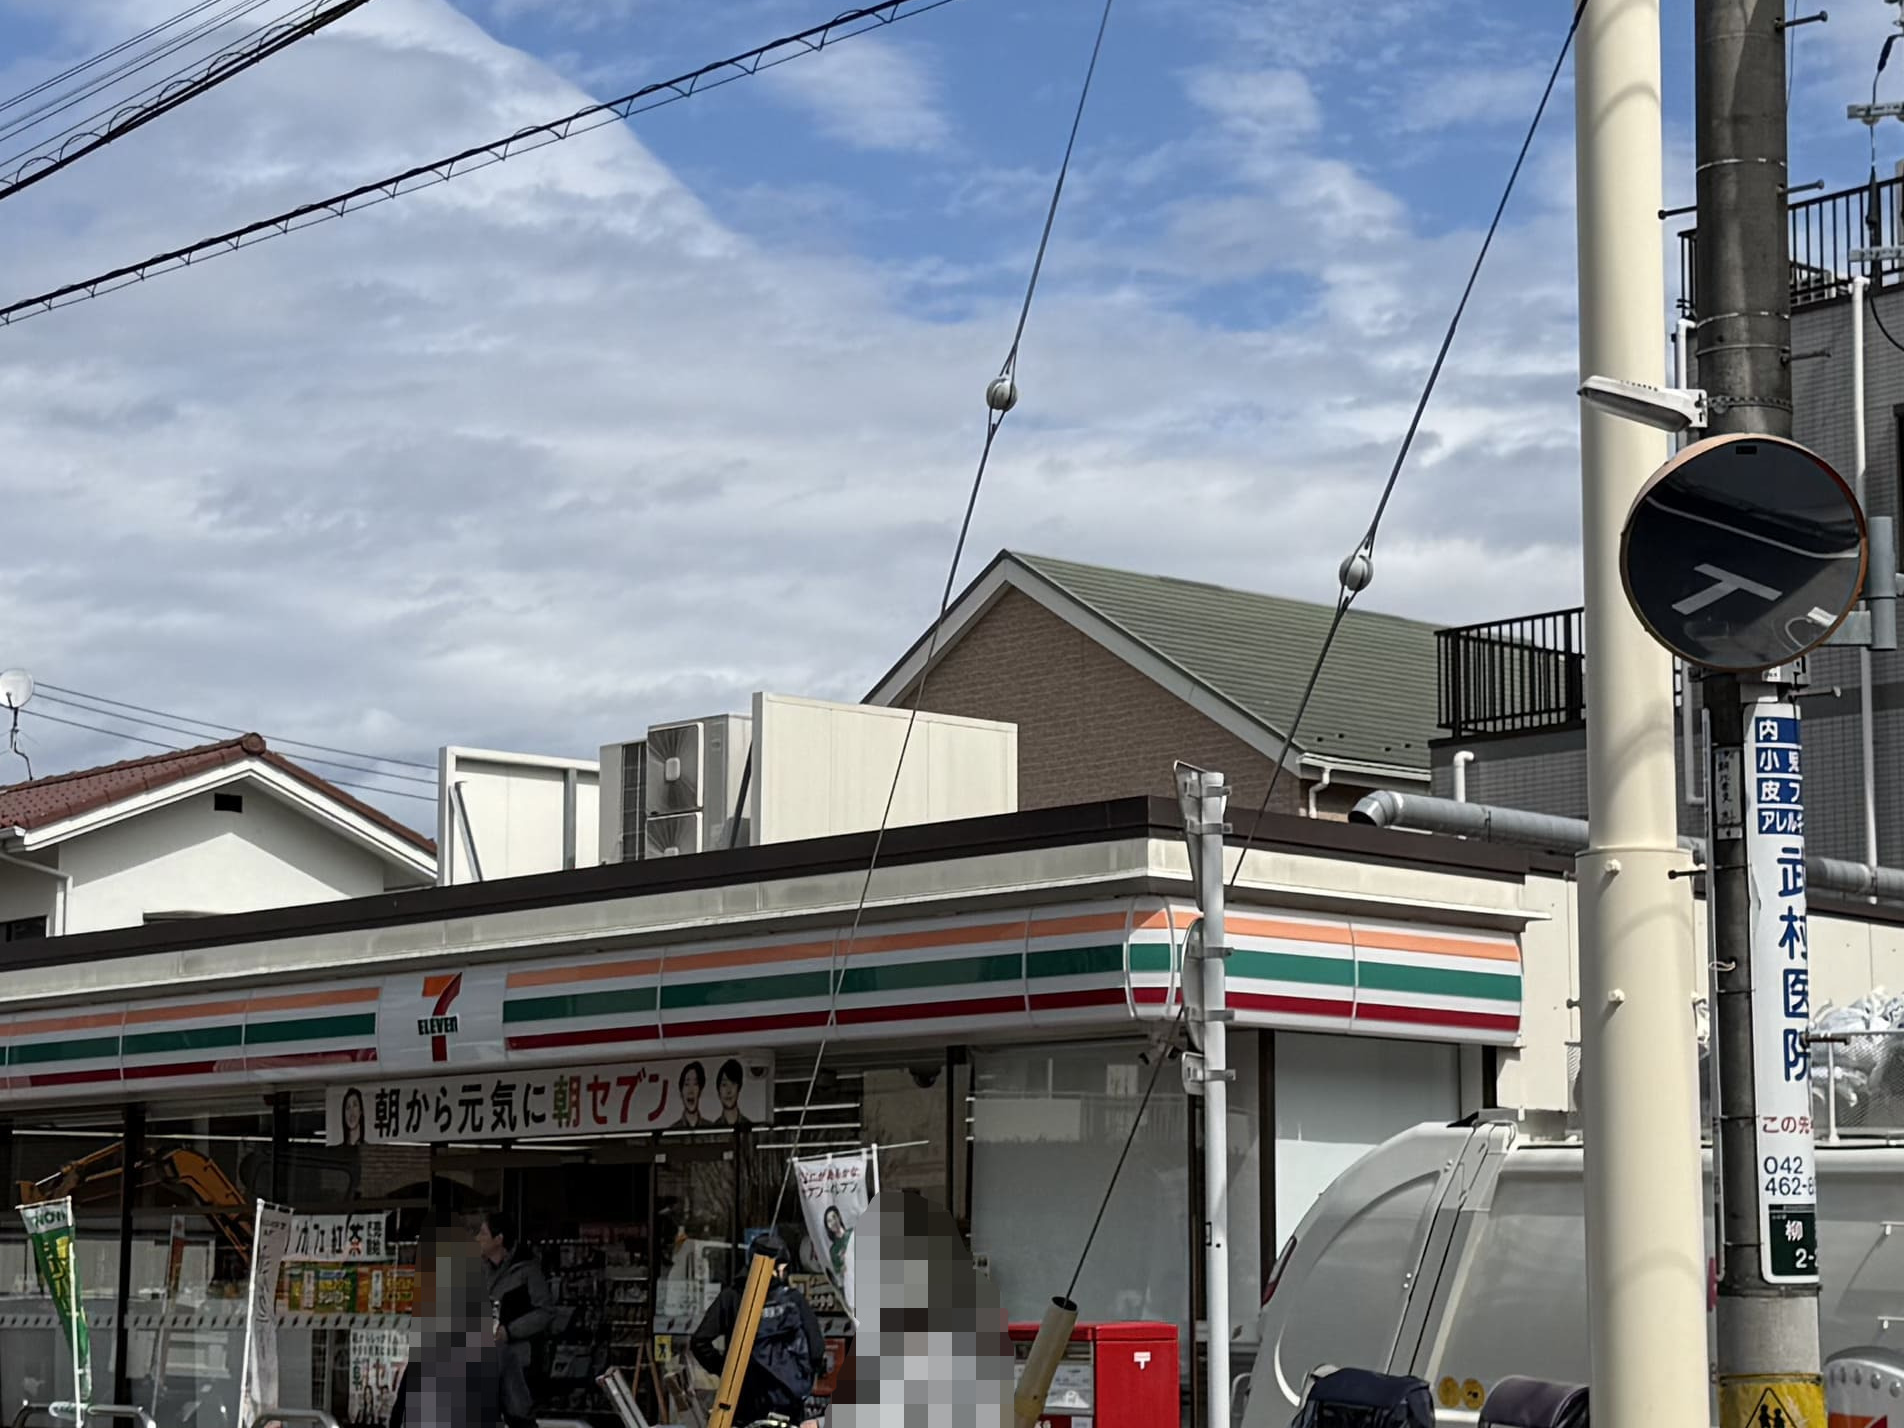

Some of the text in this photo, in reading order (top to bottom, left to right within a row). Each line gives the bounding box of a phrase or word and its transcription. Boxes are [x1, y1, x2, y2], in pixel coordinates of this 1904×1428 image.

[373, 1066, 670, 1139] 朝から元気に朝セブン
[1763, 1155, 1804, 1175] 042
[1795, 1247, 1816, 1269] 2-
